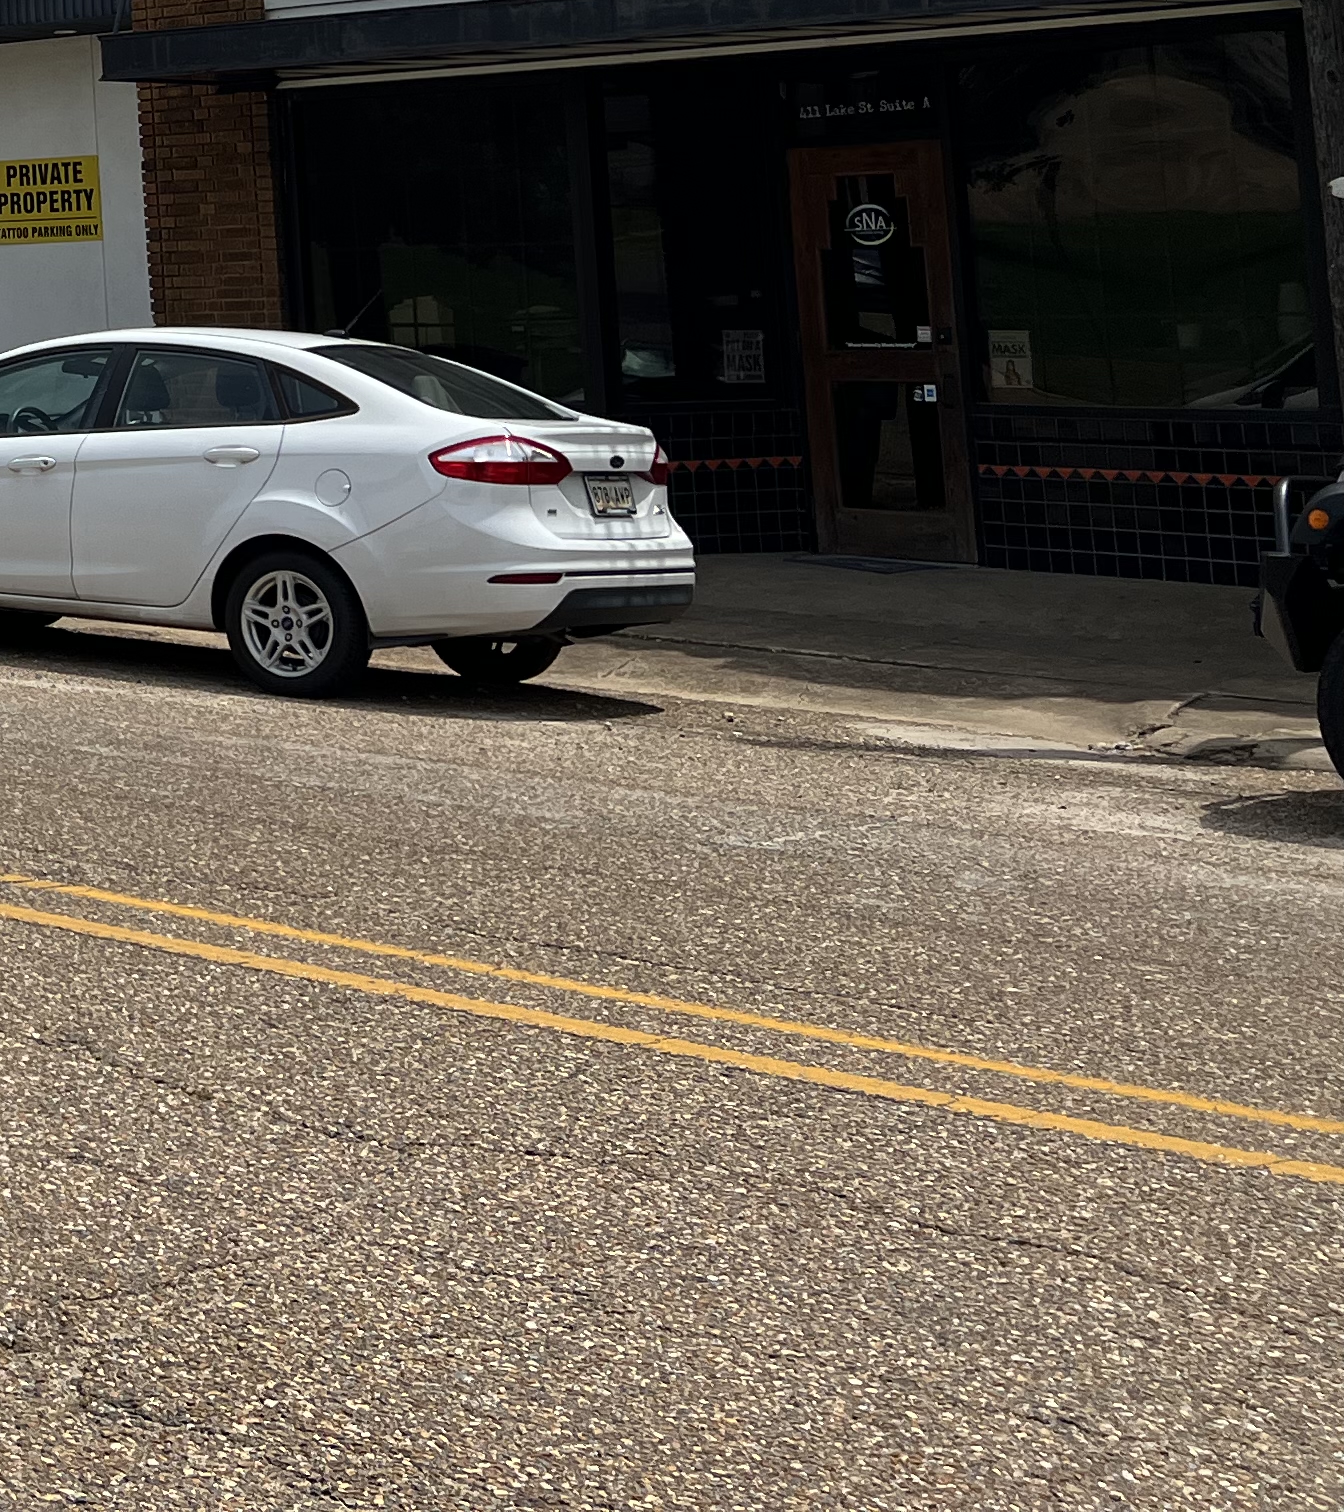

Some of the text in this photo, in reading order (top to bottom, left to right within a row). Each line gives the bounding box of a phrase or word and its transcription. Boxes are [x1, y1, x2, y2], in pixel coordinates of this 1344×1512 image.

[825, 103, 855, 117] Lake
[858, 100, 874, 114] St
[879, 99, 916, 112] Suite
[922, 96, 932, 108] A
[6, 161, 84, 187] PRIVATE
[854, 211, 887, 230] SNA
[32, 225, 72, 238] PARKING
[75, 224, 99, 237] ONLY
[992, 343, 1026, 355] MASK
[727, 353, 763, 372] MASK
